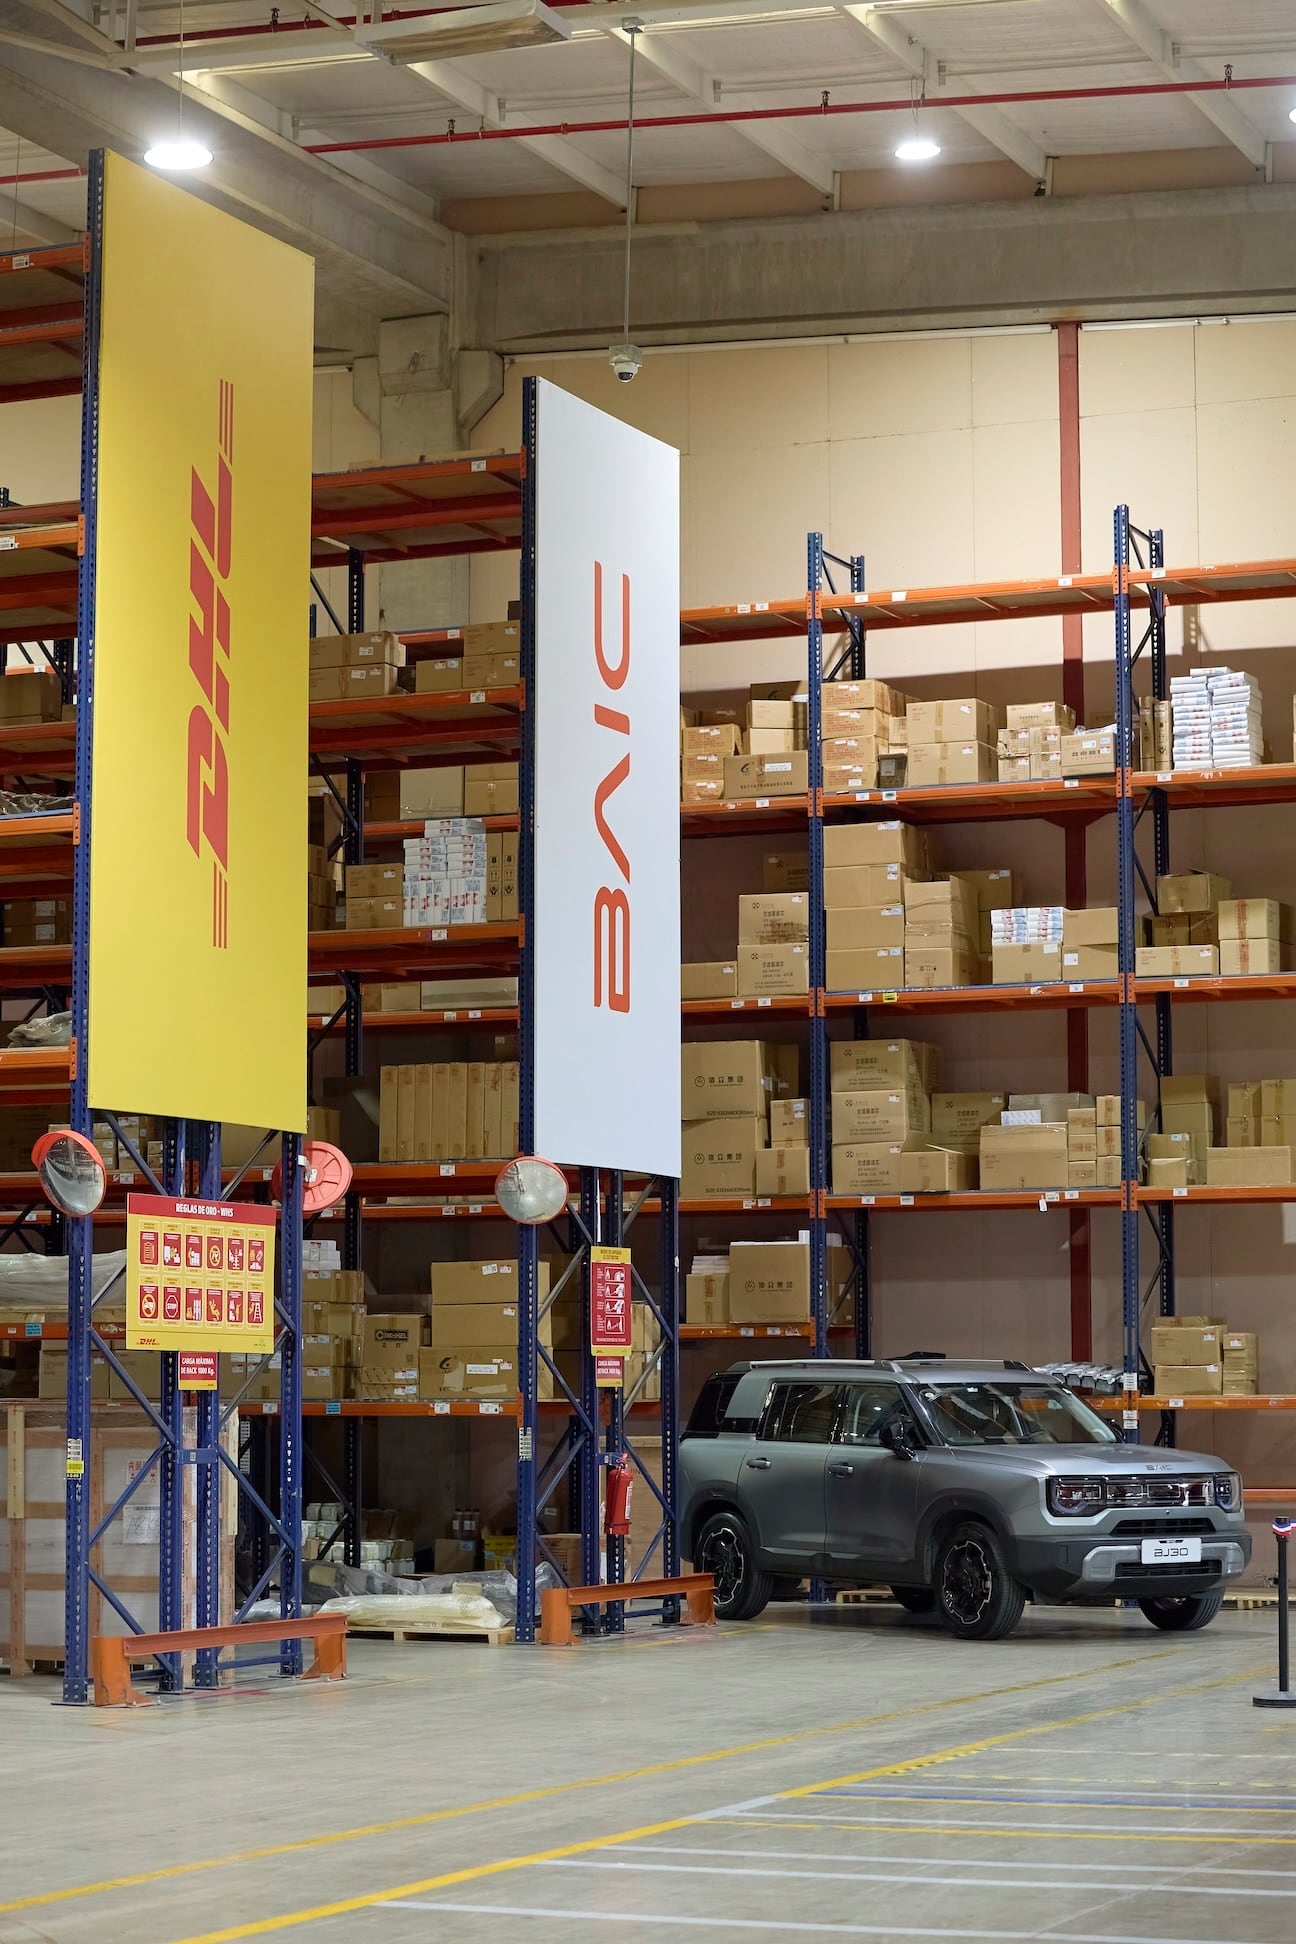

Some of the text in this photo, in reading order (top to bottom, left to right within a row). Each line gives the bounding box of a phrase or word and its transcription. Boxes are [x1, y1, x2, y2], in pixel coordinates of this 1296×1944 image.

[187, 452, 232, 873] DHL
[594, 561, 631, 1013] BAIC
[175, 1203, 197, 1214] REGLAS
[198, 1205, 205, 1215] DE
[206, 1206, 217, 1216] ORO
[220, 1207, 234, 1217] WHS
[1154, 1547, 1189, 1557] BJ30
